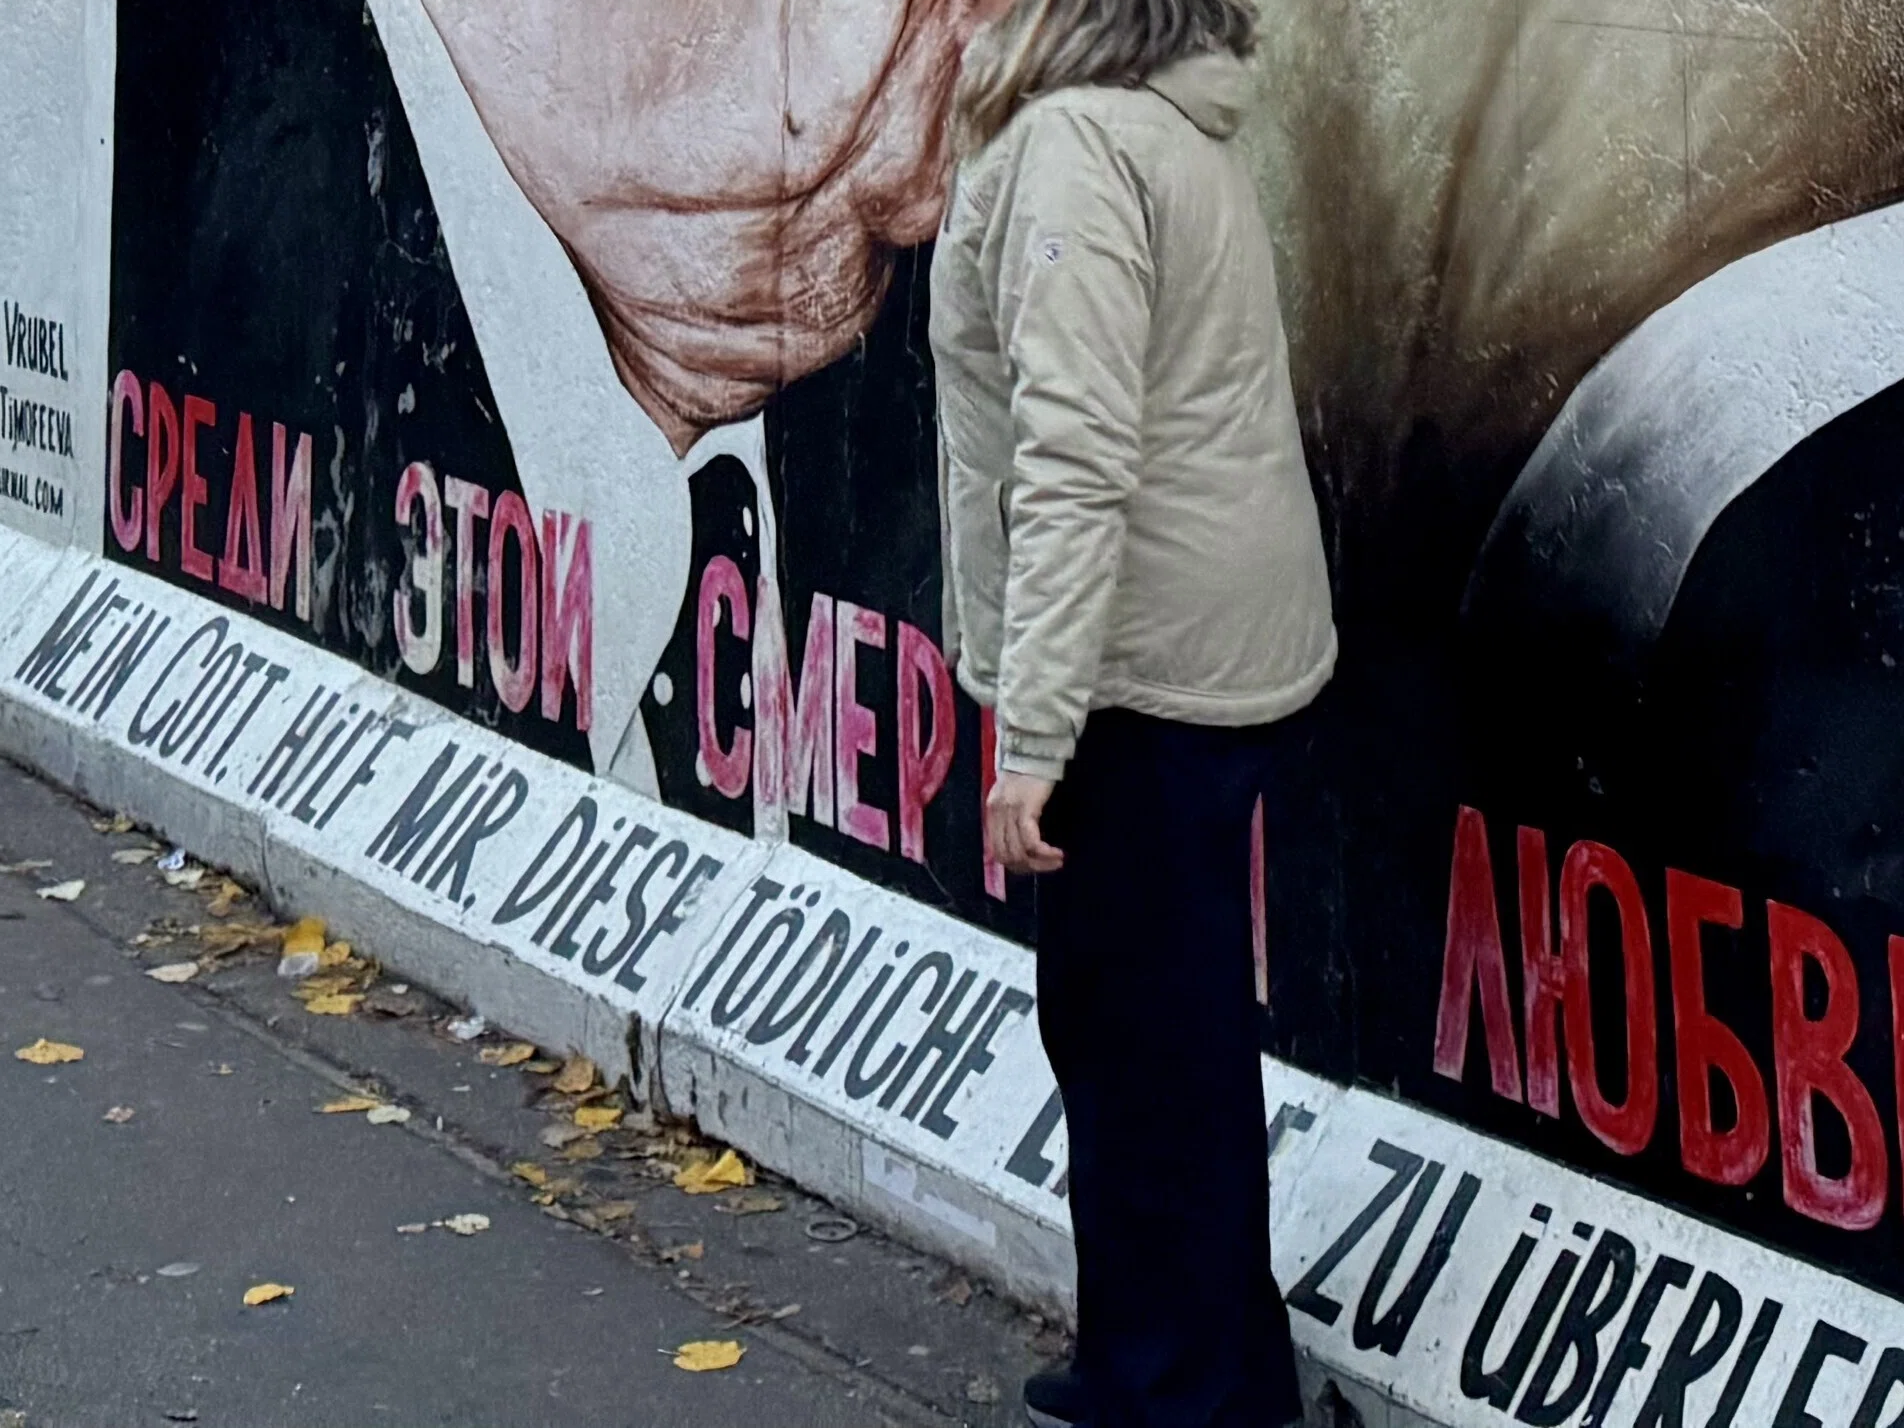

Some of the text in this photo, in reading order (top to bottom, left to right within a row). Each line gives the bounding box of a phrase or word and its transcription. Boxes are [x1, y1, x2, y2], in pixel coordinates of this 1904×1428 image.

[4, 299, 68, 382] VRUBEL
[109, 369, 313, 623] СРЕДИ
[1286, 1137, 1483, 1358] ZU
